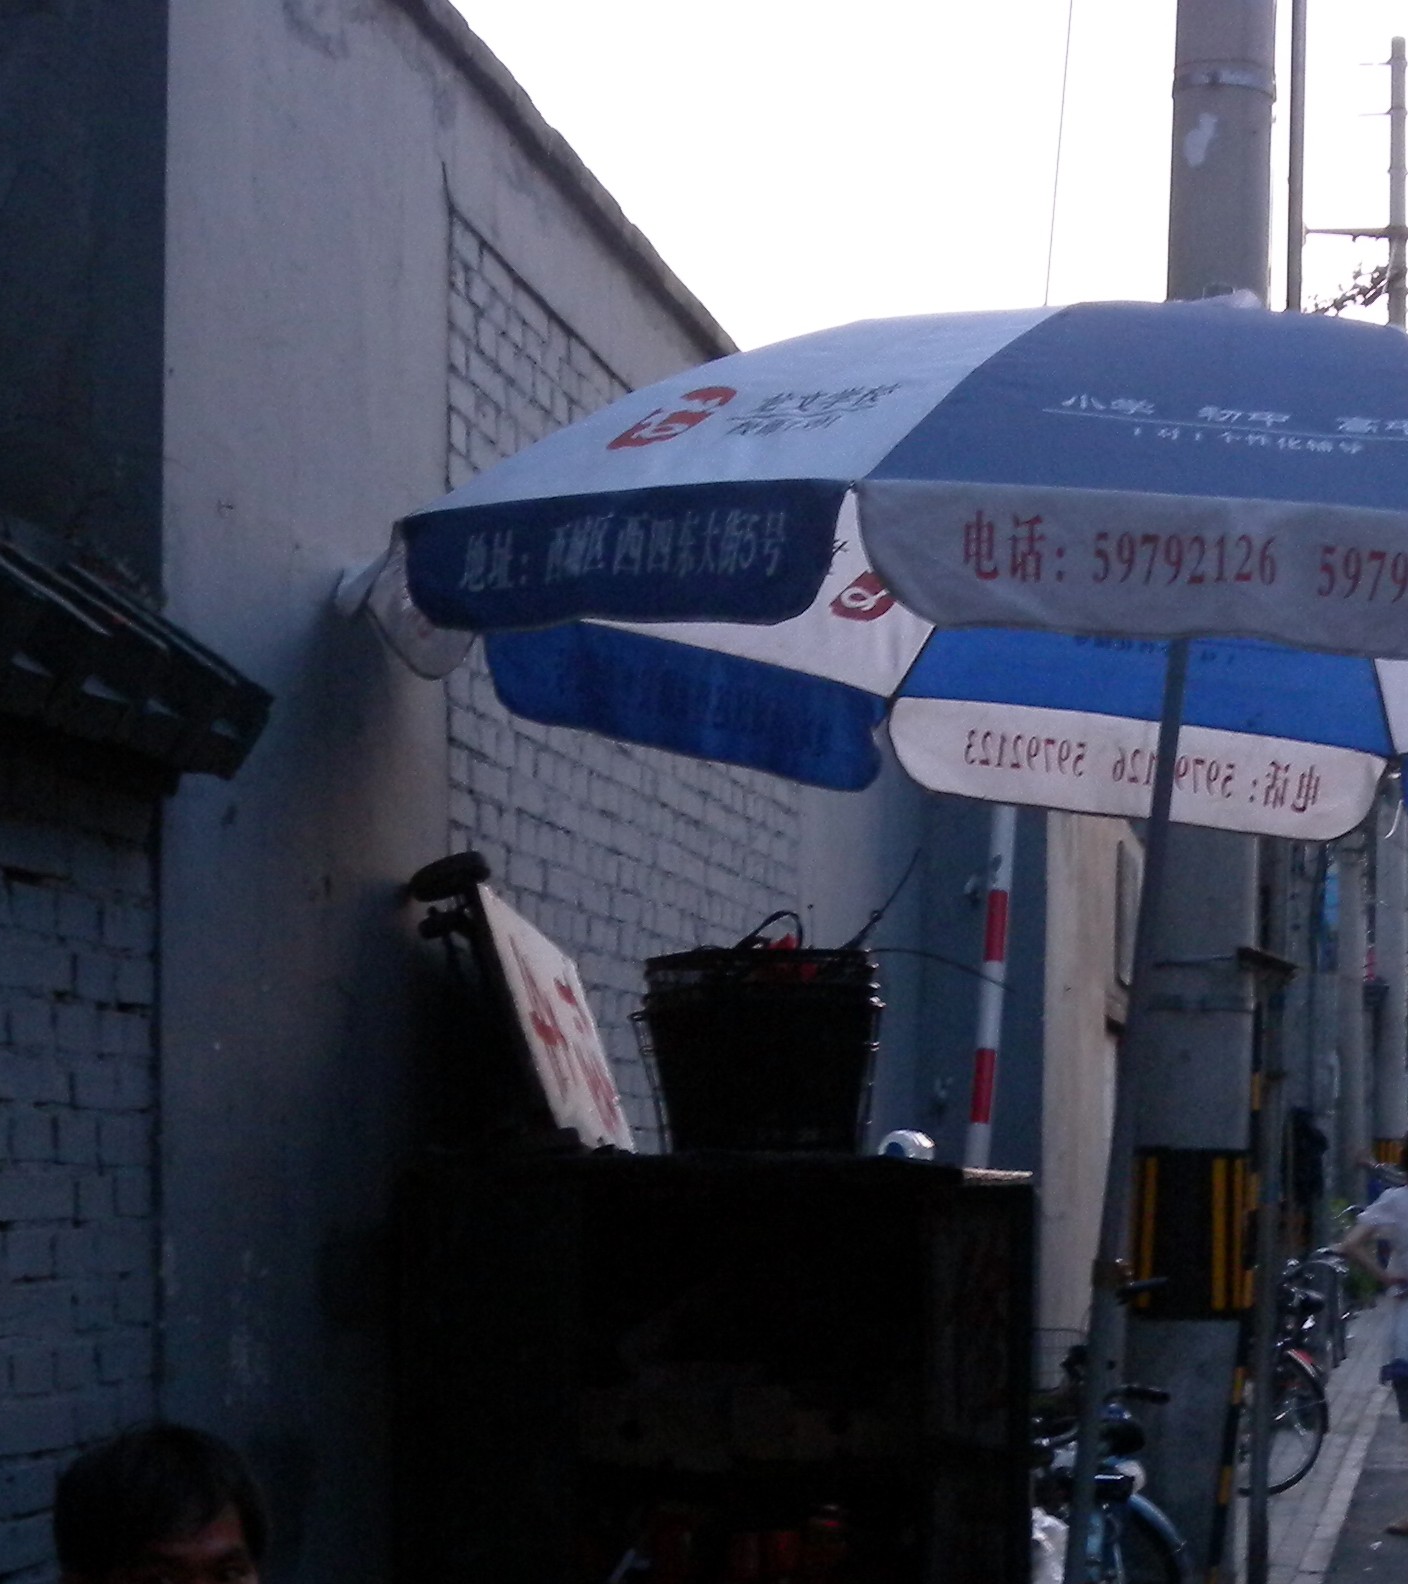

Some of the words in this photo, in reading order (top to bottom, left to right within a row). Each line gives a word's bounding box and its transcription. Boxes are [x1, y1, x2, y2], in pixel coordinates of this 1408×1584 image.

[1061, 393, 1156, 416] 小学
[1197, 404, 1292, 428] 初中
[1092, 531, 1279, 586] 59792126
